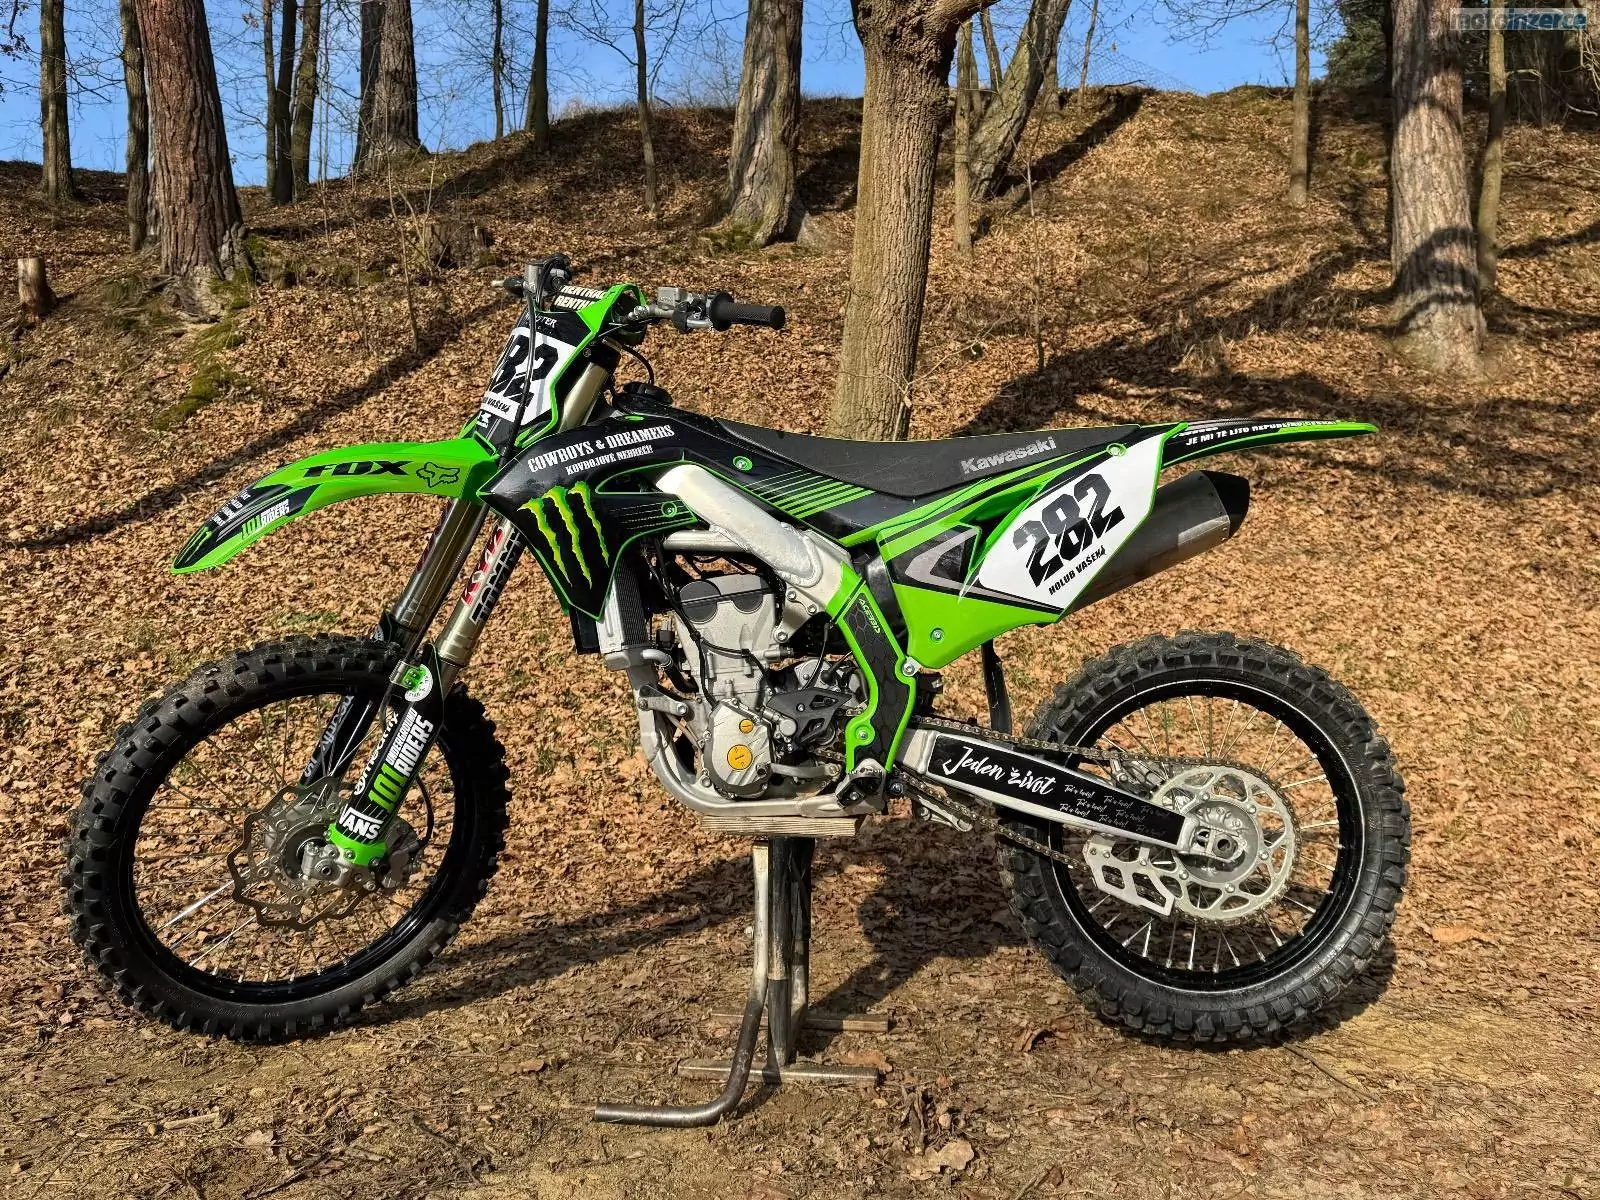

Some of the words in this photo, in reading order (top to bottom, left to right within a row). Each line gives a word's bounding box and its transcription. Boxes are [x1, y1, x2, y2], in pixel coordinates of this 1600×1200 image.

[304, 460, 415, 478] FOX
[527, 440, 595, 473] COWBOYS
[595, 435, 606, 450] &
[605, 424, 675, 450] DREAMERS
[960, 436, 1057, 474] Kawasaki
[1012, 473, 1125, 588] 282
[1048, 569, 1076, 596] HOLUB
[385, 706, 418, 766] UNDERGROUND
[394, 714, 434, 778] RIDERS
[368, 762, 408, 813] 101
[942, 746, 1006, 782] Jeden
[1007, 767, 1057, 795] život
[338, 804, 384, 840] VANS
